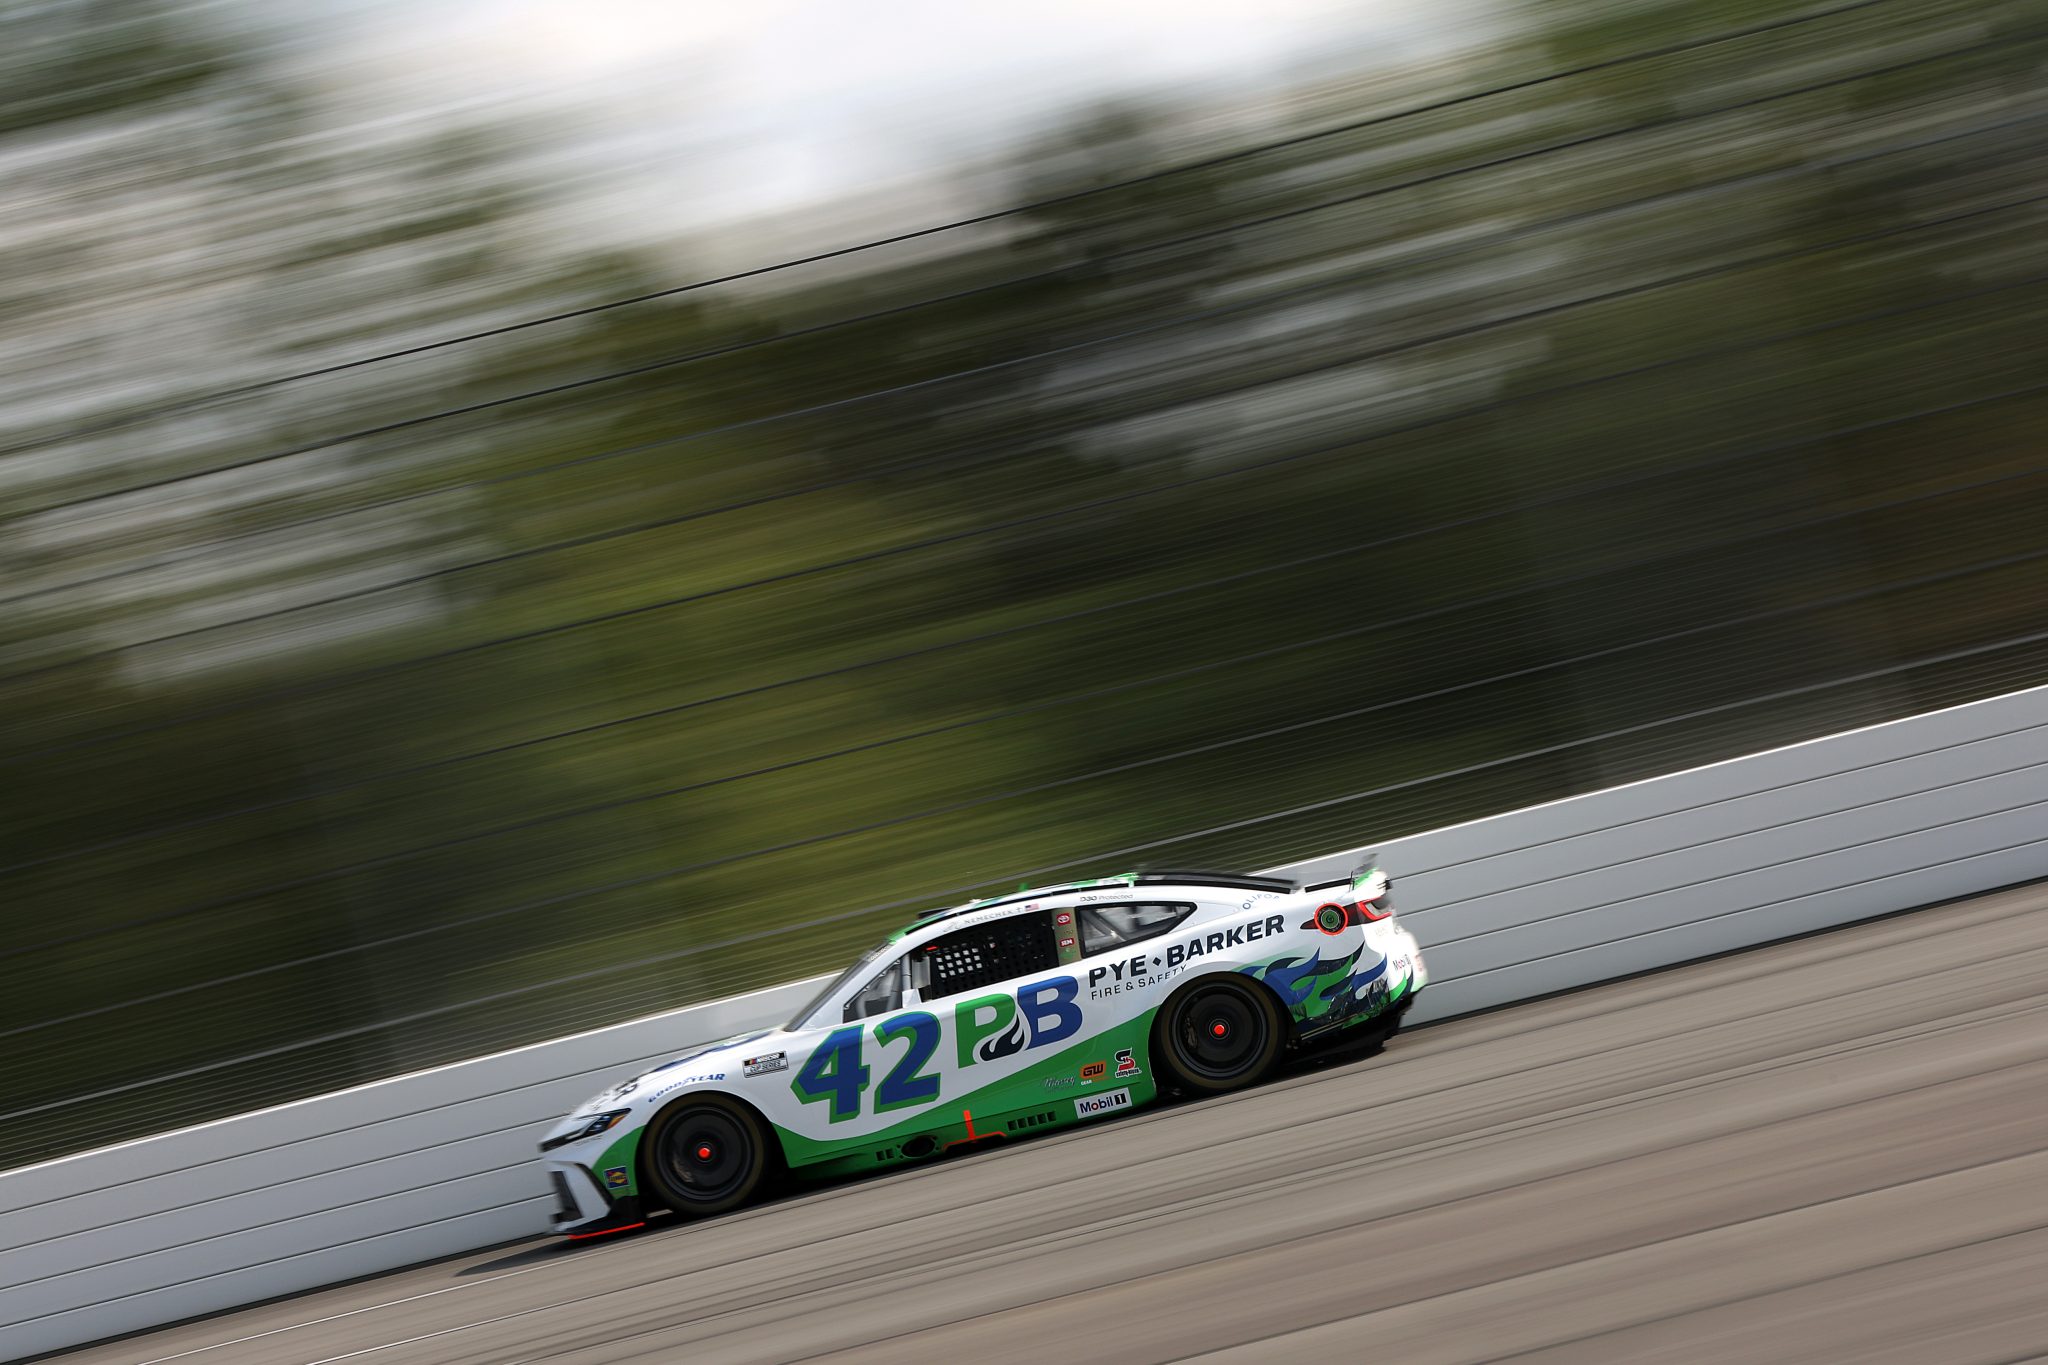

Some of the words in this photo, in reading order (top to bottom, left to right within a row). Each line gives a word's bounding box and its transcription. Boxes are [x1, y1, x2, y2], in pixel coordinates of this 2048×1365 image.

[1089, 955, 1147, 988] PYE
[1166, 914, 1285, 968] BARKER
[1091, 984, 1121, 1000] FIRE
[1125, 981, 1135, 991] &
[1138, 965, 1187, 987] SAFETY
[790, 1010, 942, 1125] 42
[1083, 1063, 1104, 1077] GW
[648, 1073, 726, 1103] GOODYEAR
[1079, 1096, 1114, 1114] Mobil
[1114, 1092, 1127, 1105] 1
